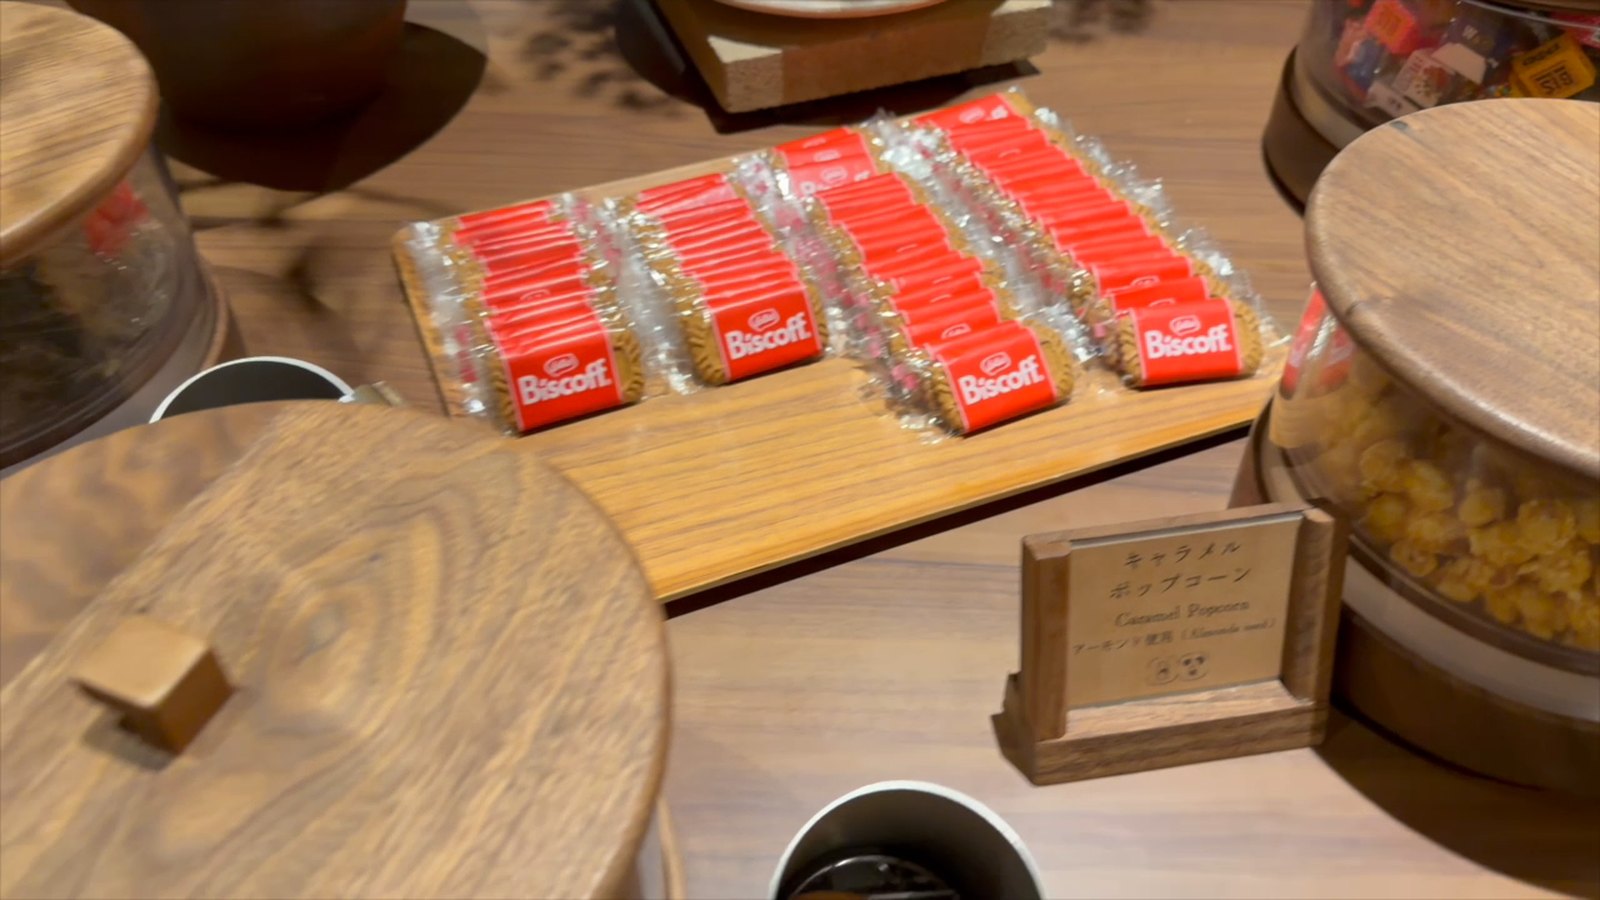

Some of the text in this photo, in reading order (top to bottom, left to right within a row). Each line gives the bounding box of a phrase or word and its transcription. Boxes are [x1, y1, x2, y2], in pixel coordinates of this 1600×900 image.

[1124, 541, 1241, 569] キャラメル
[1109, 567, 1251, 599] ポップコーン
[1115, 601, 1250, 627] Caramel Popcorn
